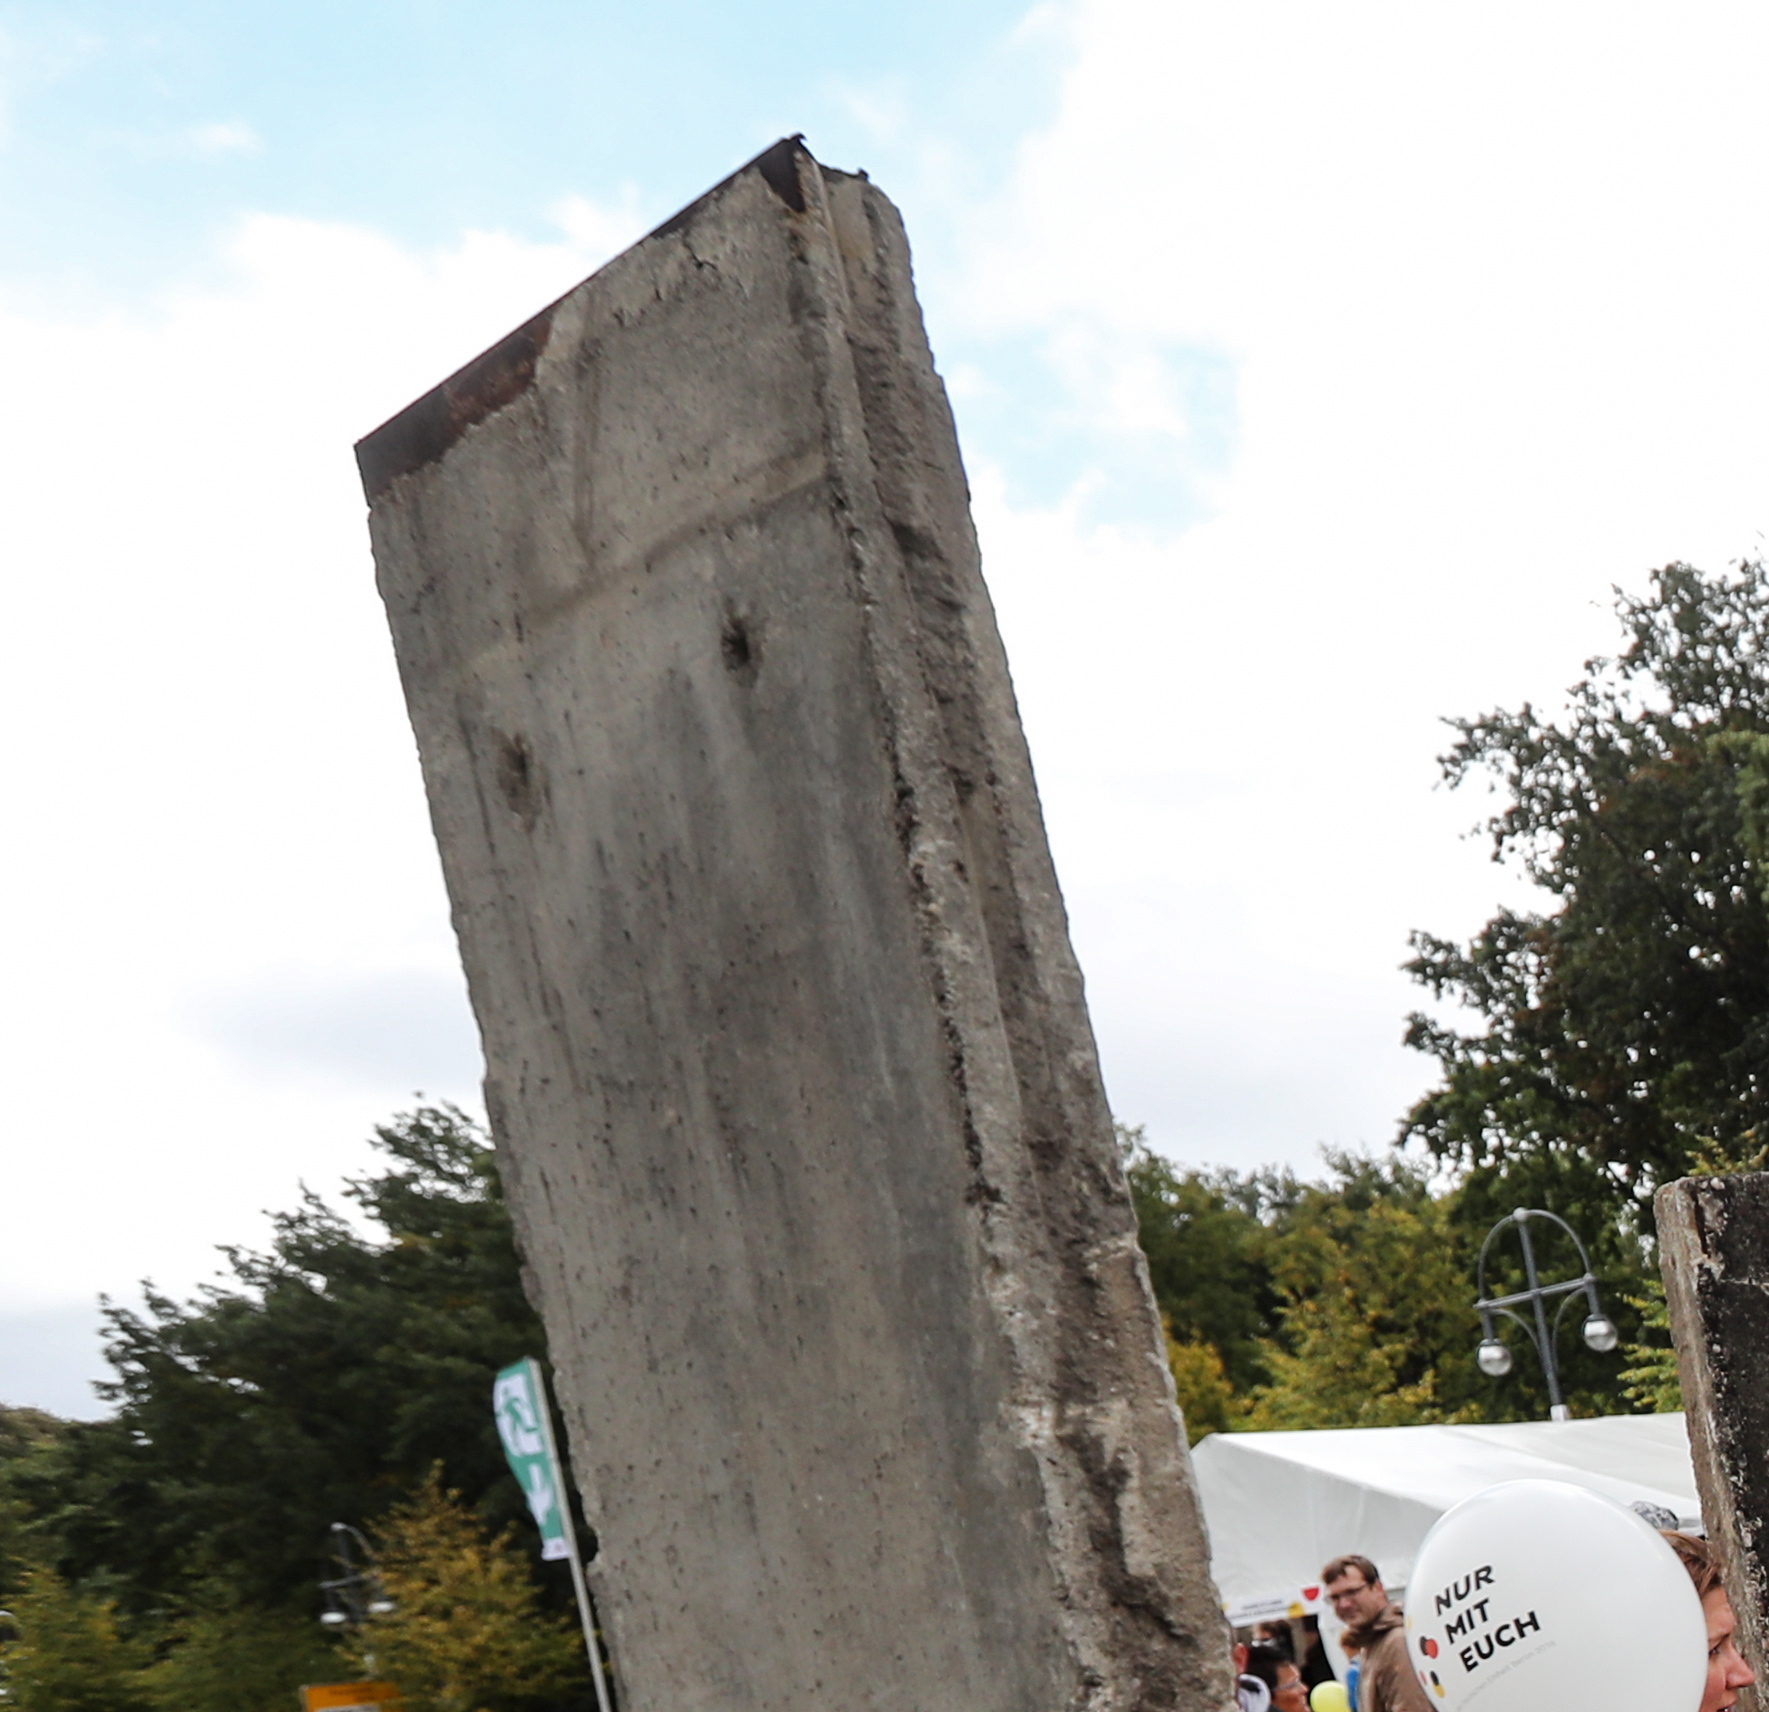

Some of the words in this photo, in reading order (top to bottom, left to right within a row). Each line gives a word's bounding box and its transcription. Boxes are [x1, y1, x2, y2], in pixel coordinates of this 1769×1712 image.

[1434, 1564, 1495, 1617] NUR
[1444, 1597, 1490, 1645] MIT
[1459, 1610, 1541, 1673] EUCH
